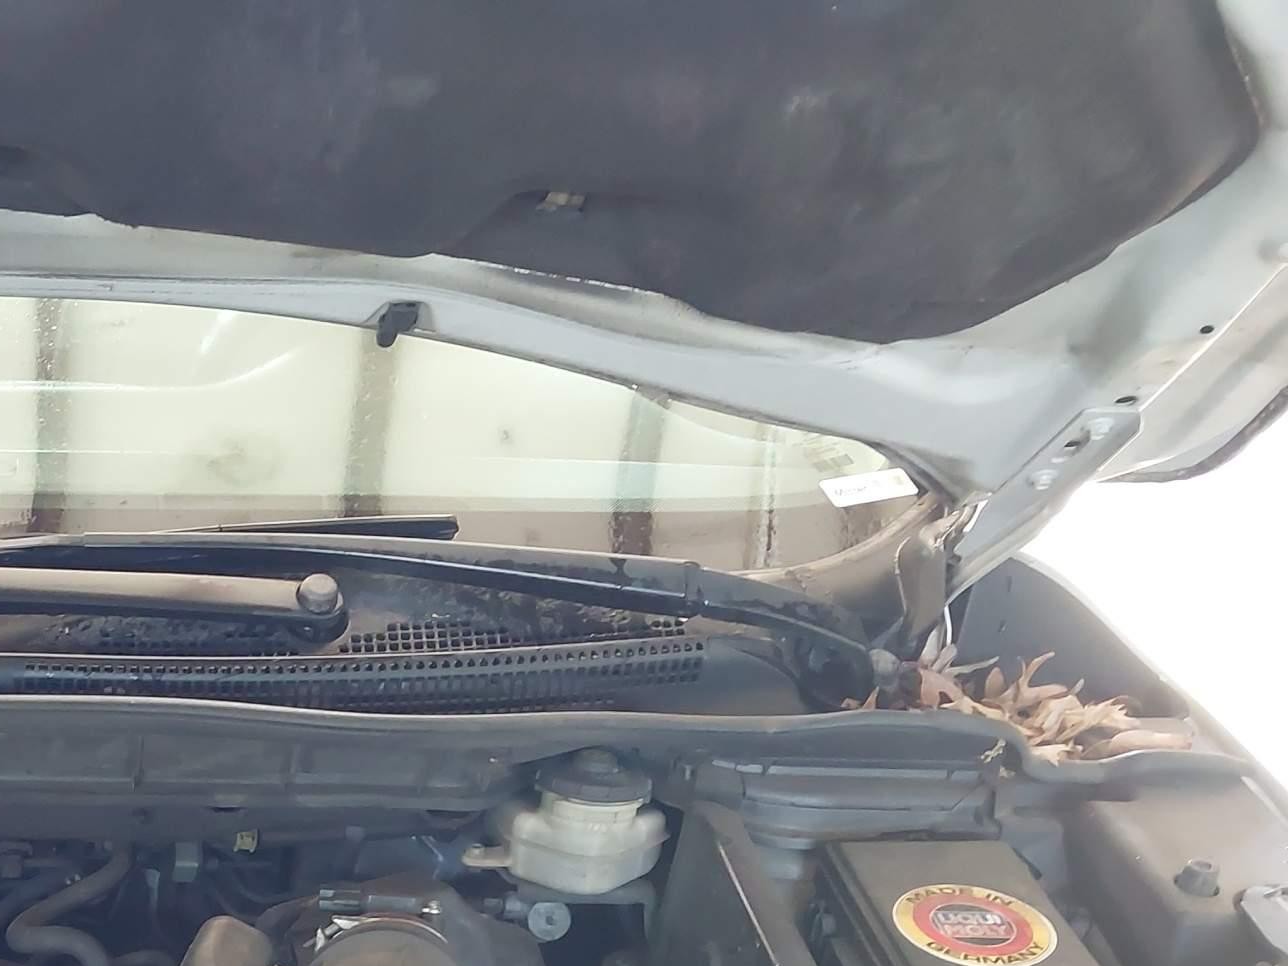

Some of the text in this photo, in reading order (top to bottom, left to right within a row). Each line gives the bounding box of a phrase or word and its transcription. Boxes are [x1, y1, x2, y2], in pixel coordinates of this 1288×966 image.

[906, 886, 1013, 906] MADE IN
[941, 923, 1008, 938] MOLY
[926, 940, 1045, 965] GERMANY
